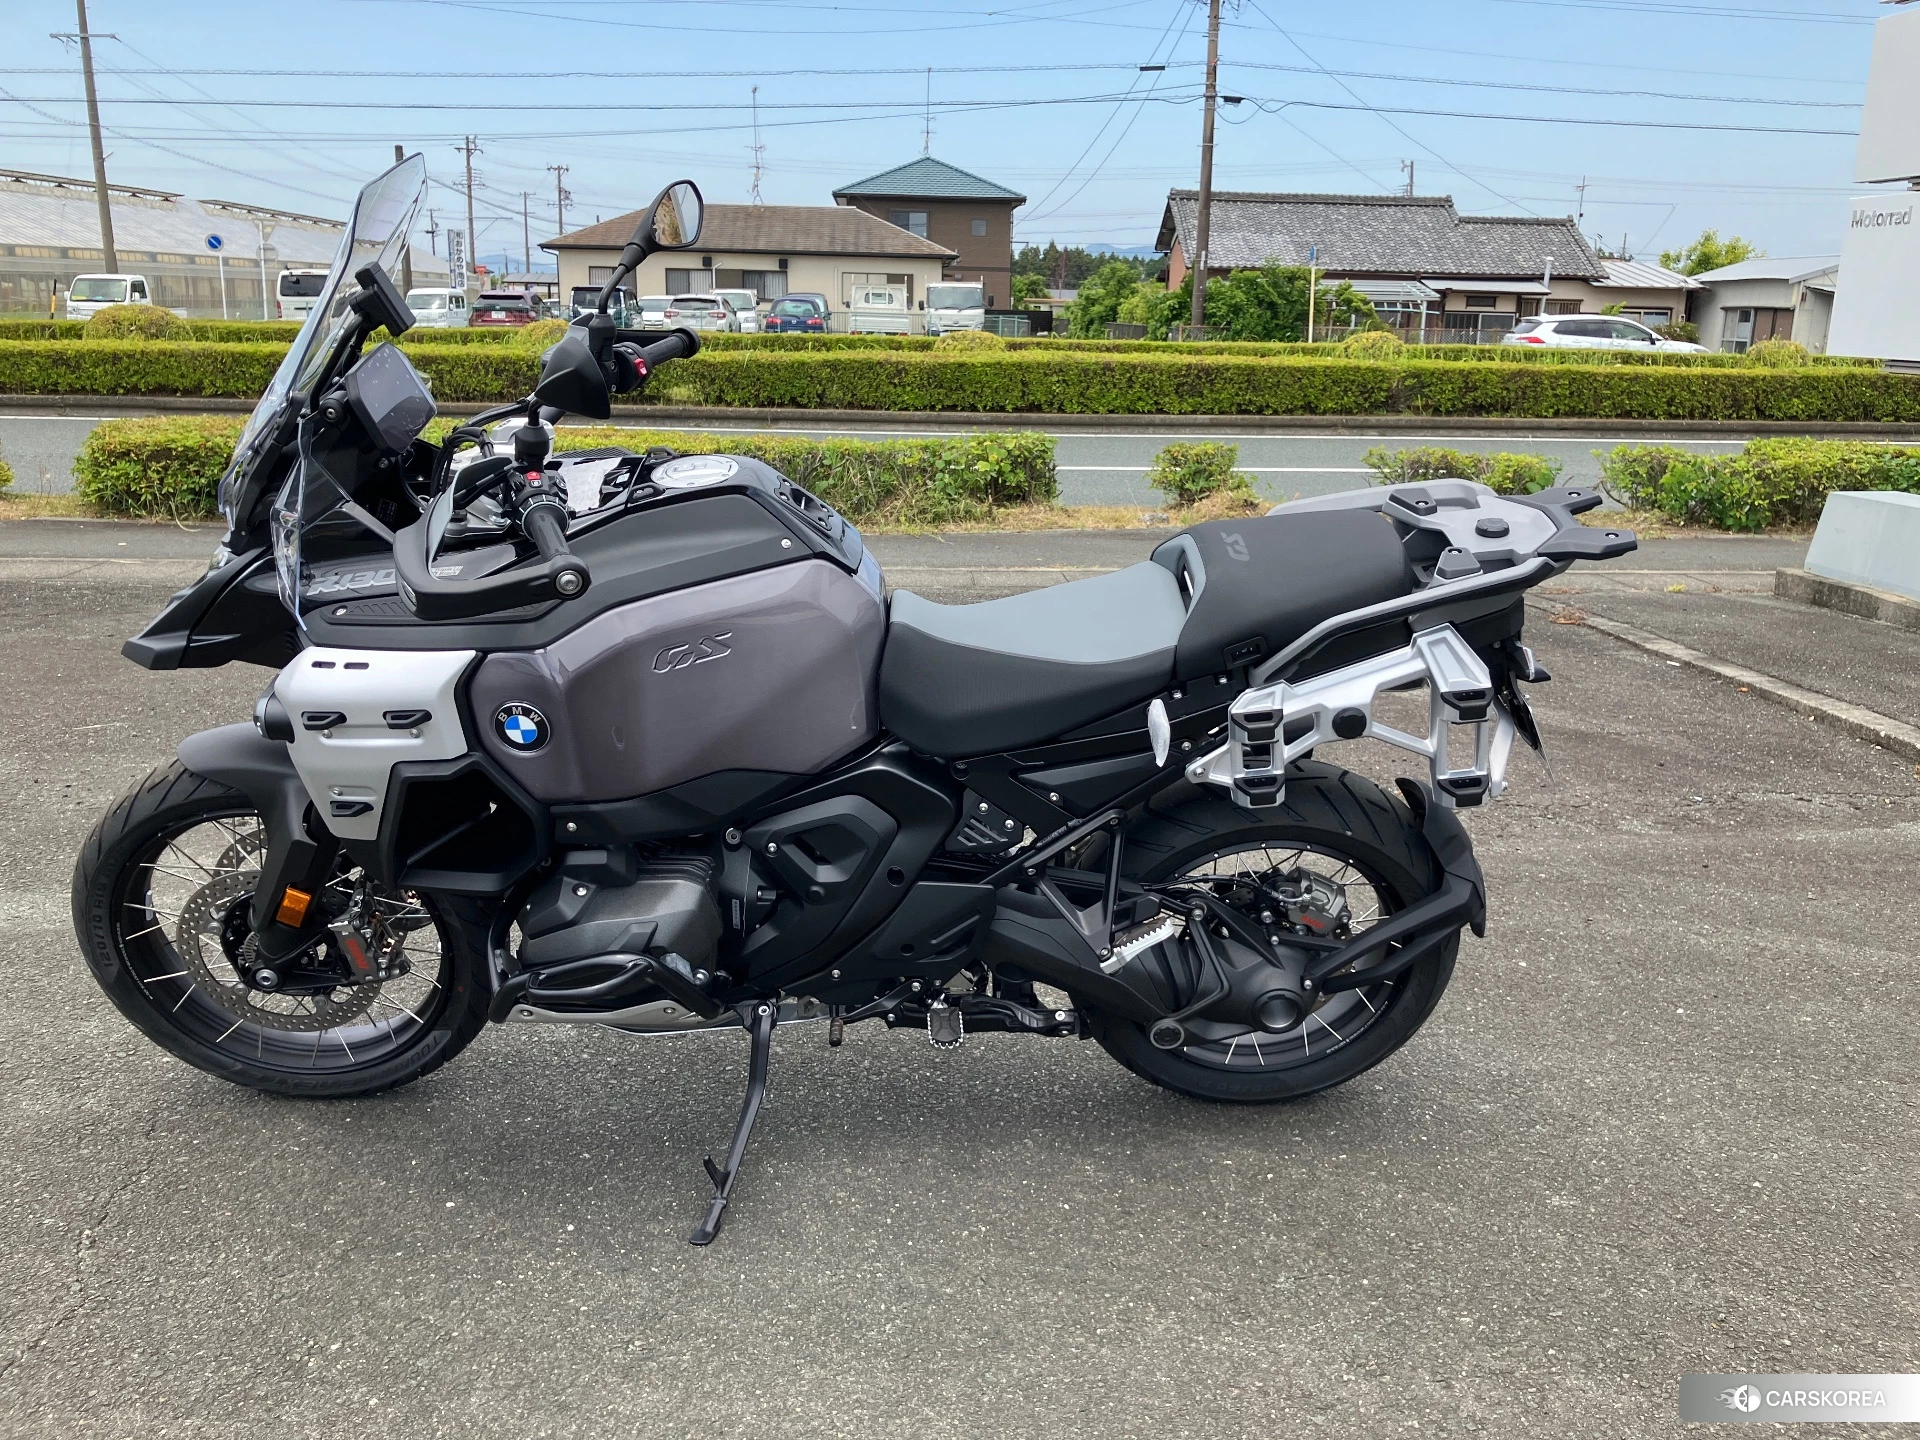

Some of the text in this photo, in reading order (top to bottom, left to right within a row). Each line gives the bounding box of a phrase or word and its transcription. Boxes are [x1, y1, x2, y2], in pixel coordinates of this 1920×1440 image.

[1851, 205, 1913, 228] Motorrad
[652, 630, 732, 674] GS
[497, 705, 542, 723] BMW
